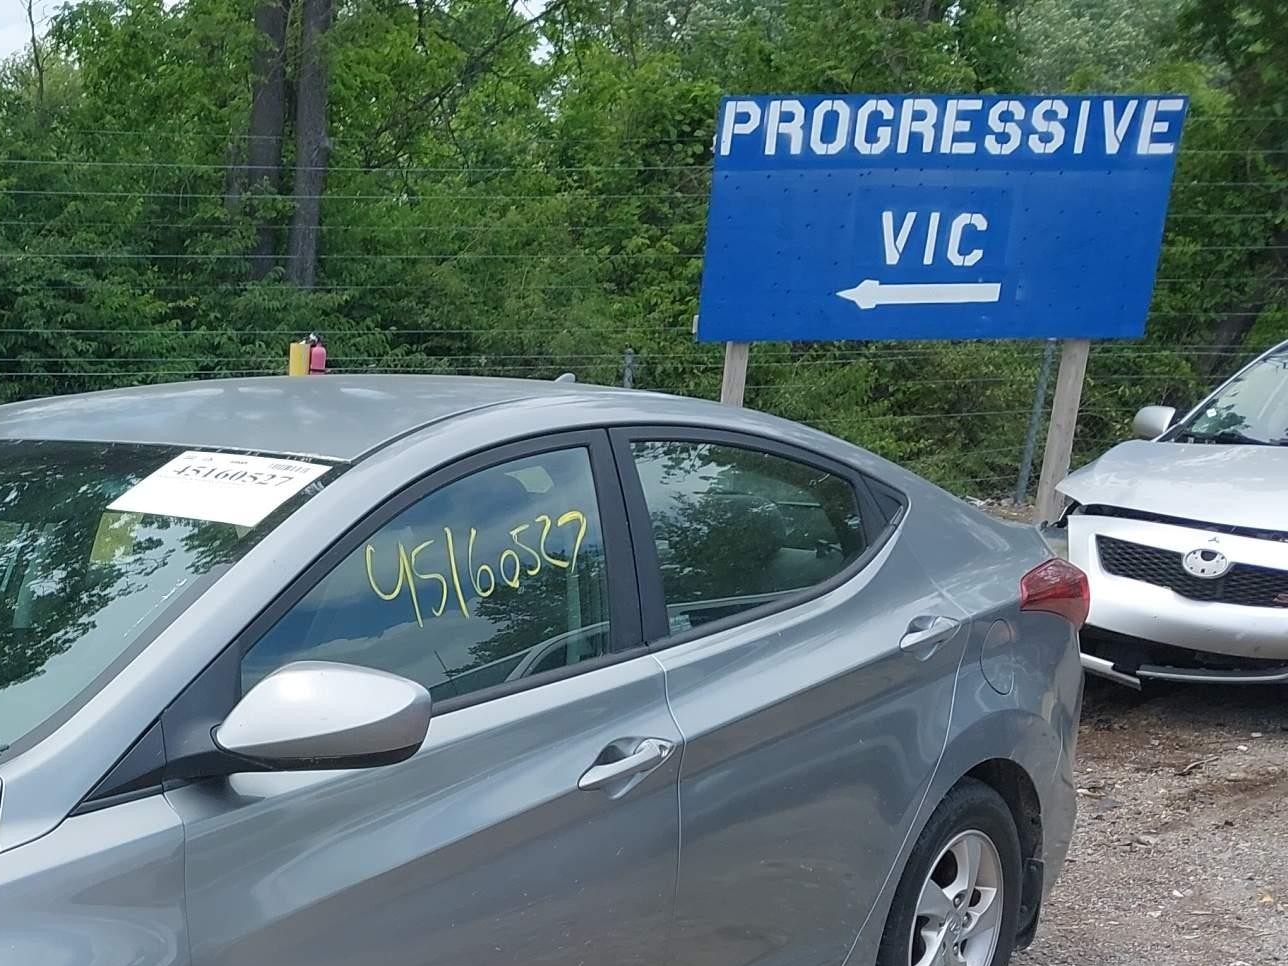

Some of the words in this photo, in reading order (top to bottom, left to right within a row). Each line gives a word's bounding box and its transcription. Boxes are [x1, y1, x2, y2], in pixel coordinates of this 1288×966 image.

[720, 98, 1183, 156] PROGRESSIVE
[882, 212, 988, 266] VIC
[173, 465, 294, 486] 45160527
[365, 510, 587, 628] 45160527
